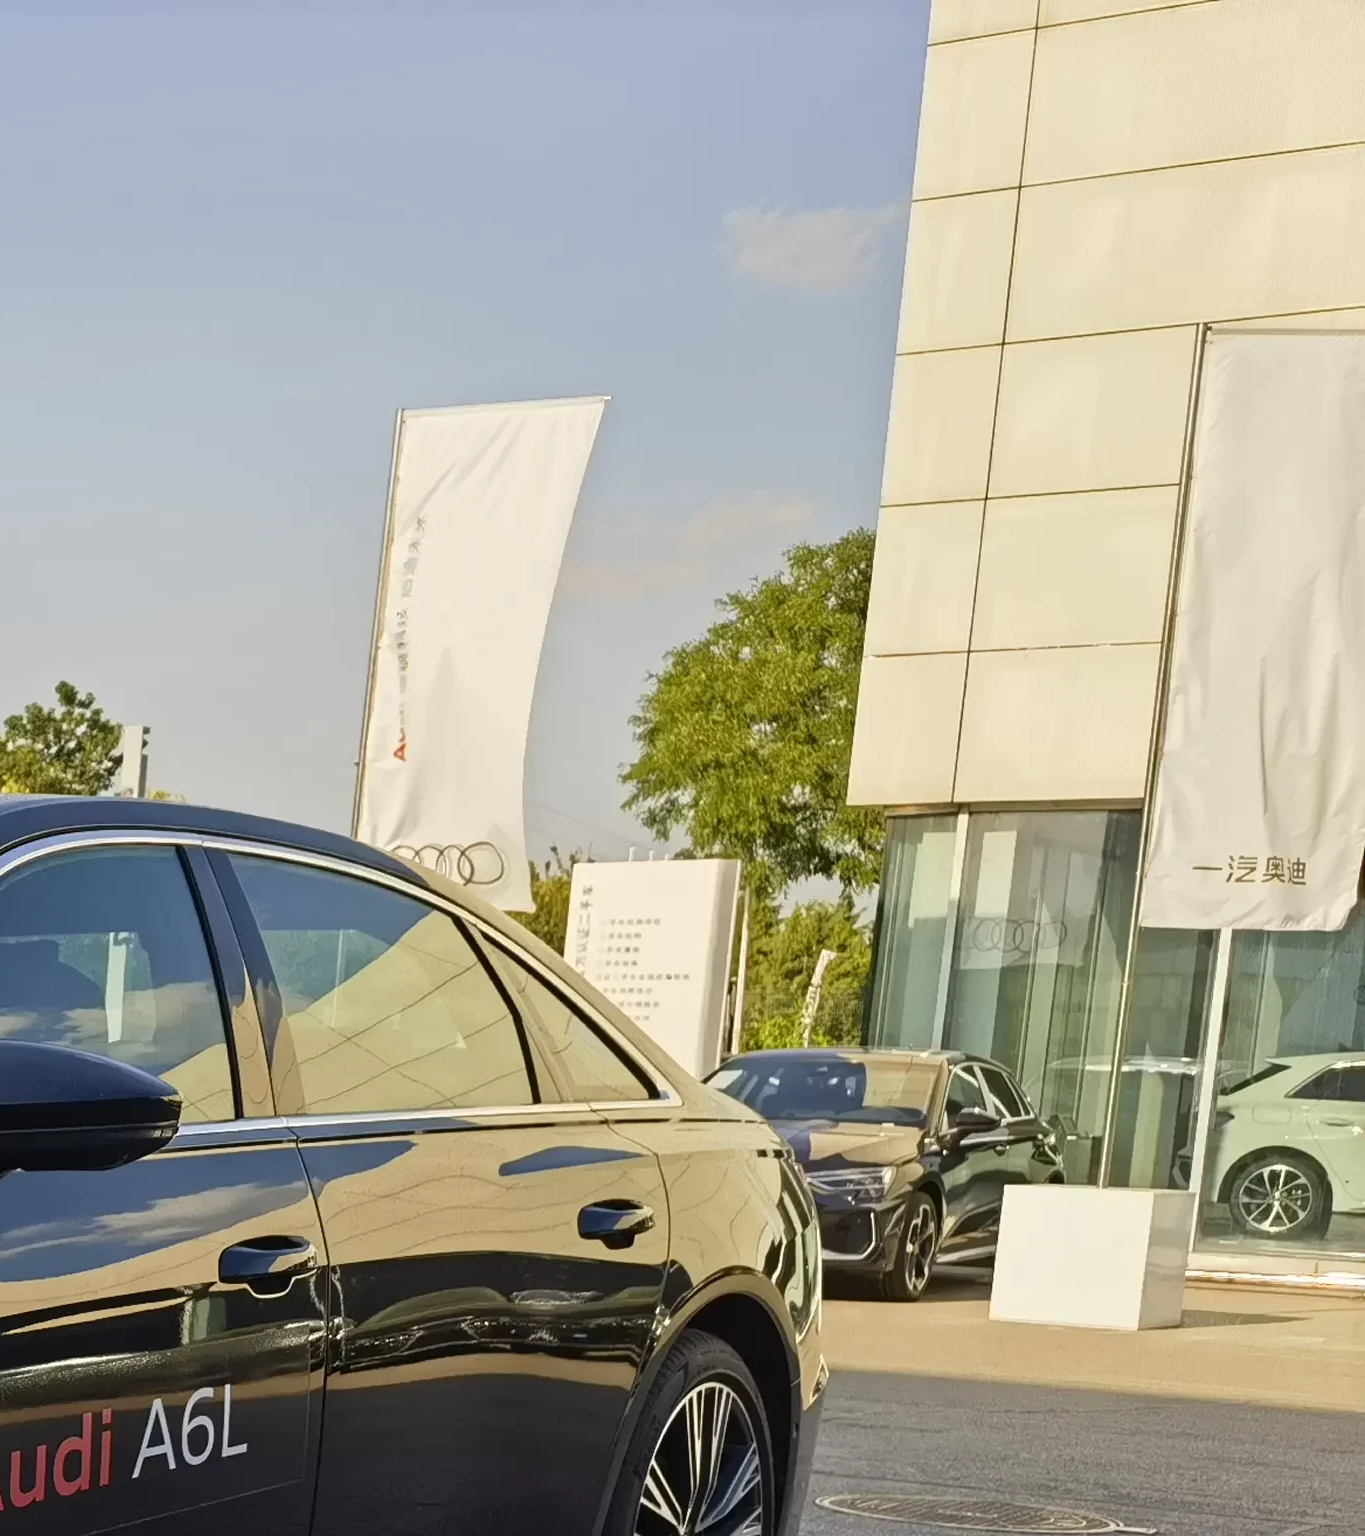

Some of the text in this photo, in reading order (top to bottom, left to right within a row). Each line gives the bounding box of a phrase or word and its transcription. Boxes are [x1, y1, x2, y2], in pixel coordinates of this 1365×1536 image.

[1192, 855, 1307, 885] 一汽奥迪
[131, 1384, 248, 1479] A6L
